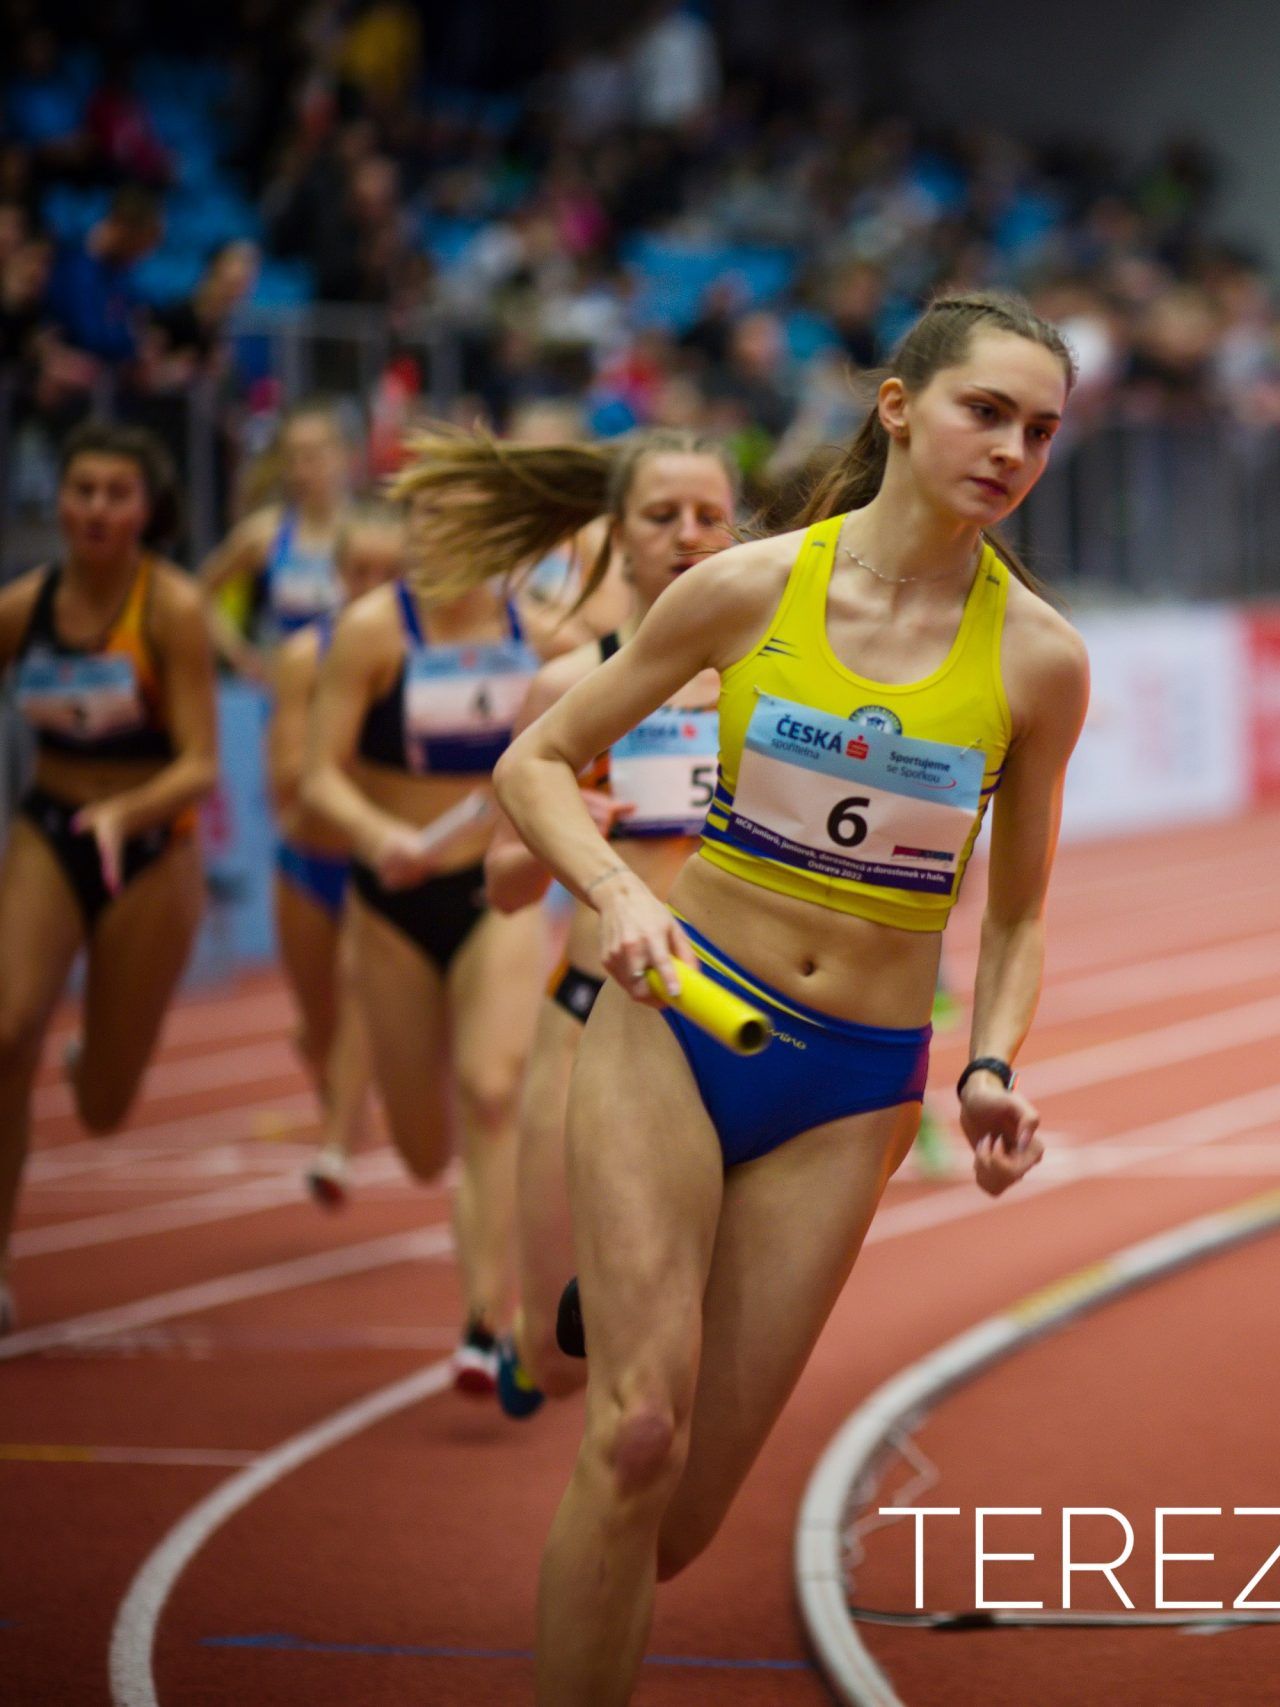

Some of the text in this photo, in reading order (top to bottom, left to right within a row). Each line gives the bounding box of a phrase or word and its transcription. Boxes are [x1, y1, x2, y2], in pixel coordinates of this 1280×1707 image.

[776, 714, 842, 754] ČESKÁ
[771, 738, 820, 760] spořitelna
[886, 764, 898, 774] se
[889, 750, 951, 772] Sportujeme
[690, 766, 714, 808] 5
[827, 796, 870, 848] 6
[808, 860, 863, 881] Ostrava 2022
